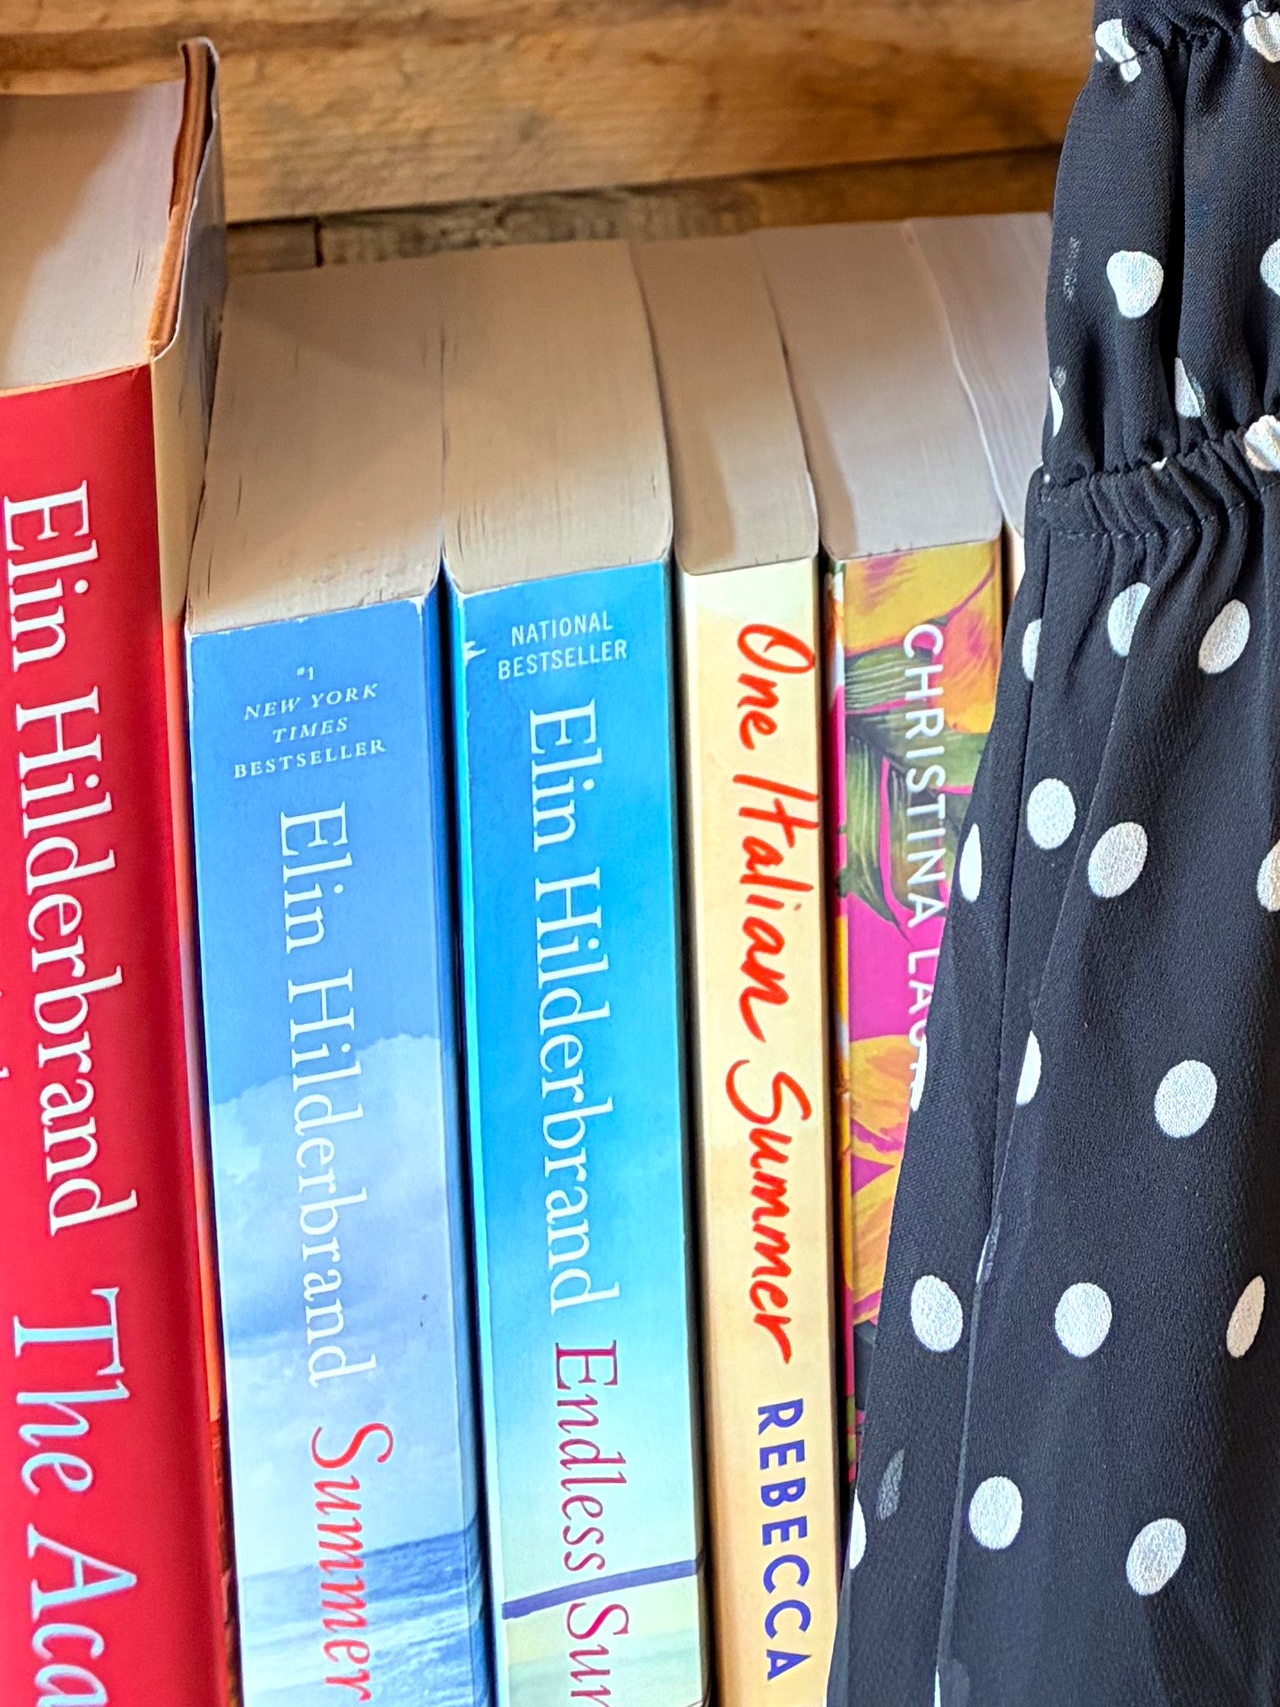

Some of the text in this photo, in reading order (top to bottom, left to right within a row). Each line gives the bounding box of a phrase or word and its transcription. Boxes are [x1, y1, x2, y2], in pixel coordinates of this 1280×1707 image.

[4, 480, 98, 671] Elin
[497, 637, 629, 681] BESTSELLER
[510, 611, 616, 645] NATIONAL
[233, 738, 388, 779] BESTSELLER
[243, 682, 379, 721] NEW YORK
[271, 716, 349, 744] TIMES
[527, 698, 602, 854] Elin
[903, 623, 947, 929] CHRISTINA
[15, 685, 139, 1239] Hilderbrand
[533, 864, 623, 1316] Hilderbrand
[725, 622, 816, 1681] One Italian Summer REBECCA
[278, 801, 394, 1702] Elin Hilderbrand Summer
[12, 1286, 130, 1496] The
[555, 1339, 628, 1572] Endless
